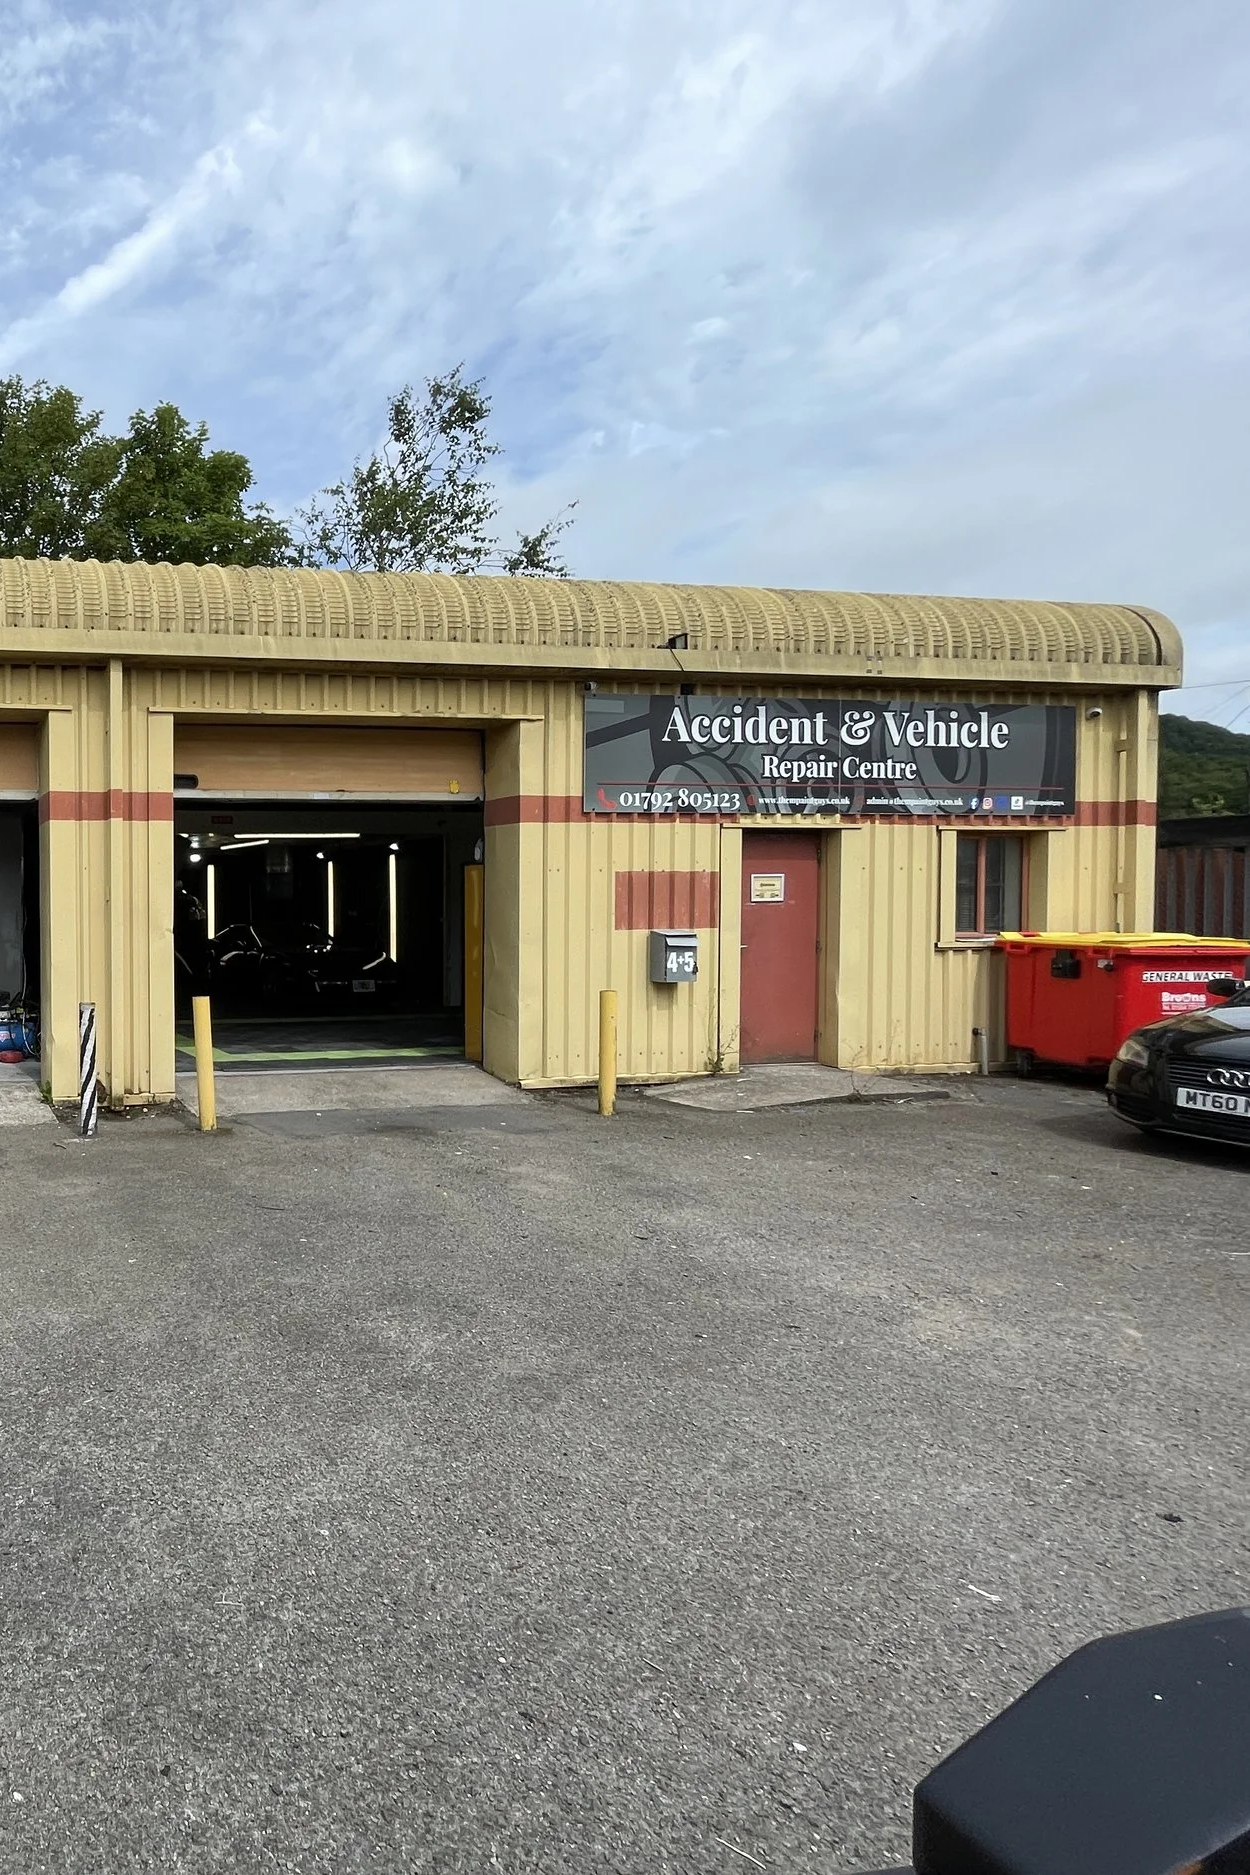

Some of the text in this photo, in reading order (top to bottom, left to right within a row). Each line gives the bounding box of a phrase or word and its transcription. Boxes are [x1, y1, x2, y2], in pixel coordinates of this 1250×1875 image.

[661, 705, 1010, 749] Accident & Vehicle
[762, 754, 918, 783] Repair Centre
[619, 788, 741, 811] 01792 805123
[666, 951, 695, 973] 4+5
[1142, 971, 1191, 982] GENERAL
[1185, 1090, 1238, 1111] MT60
